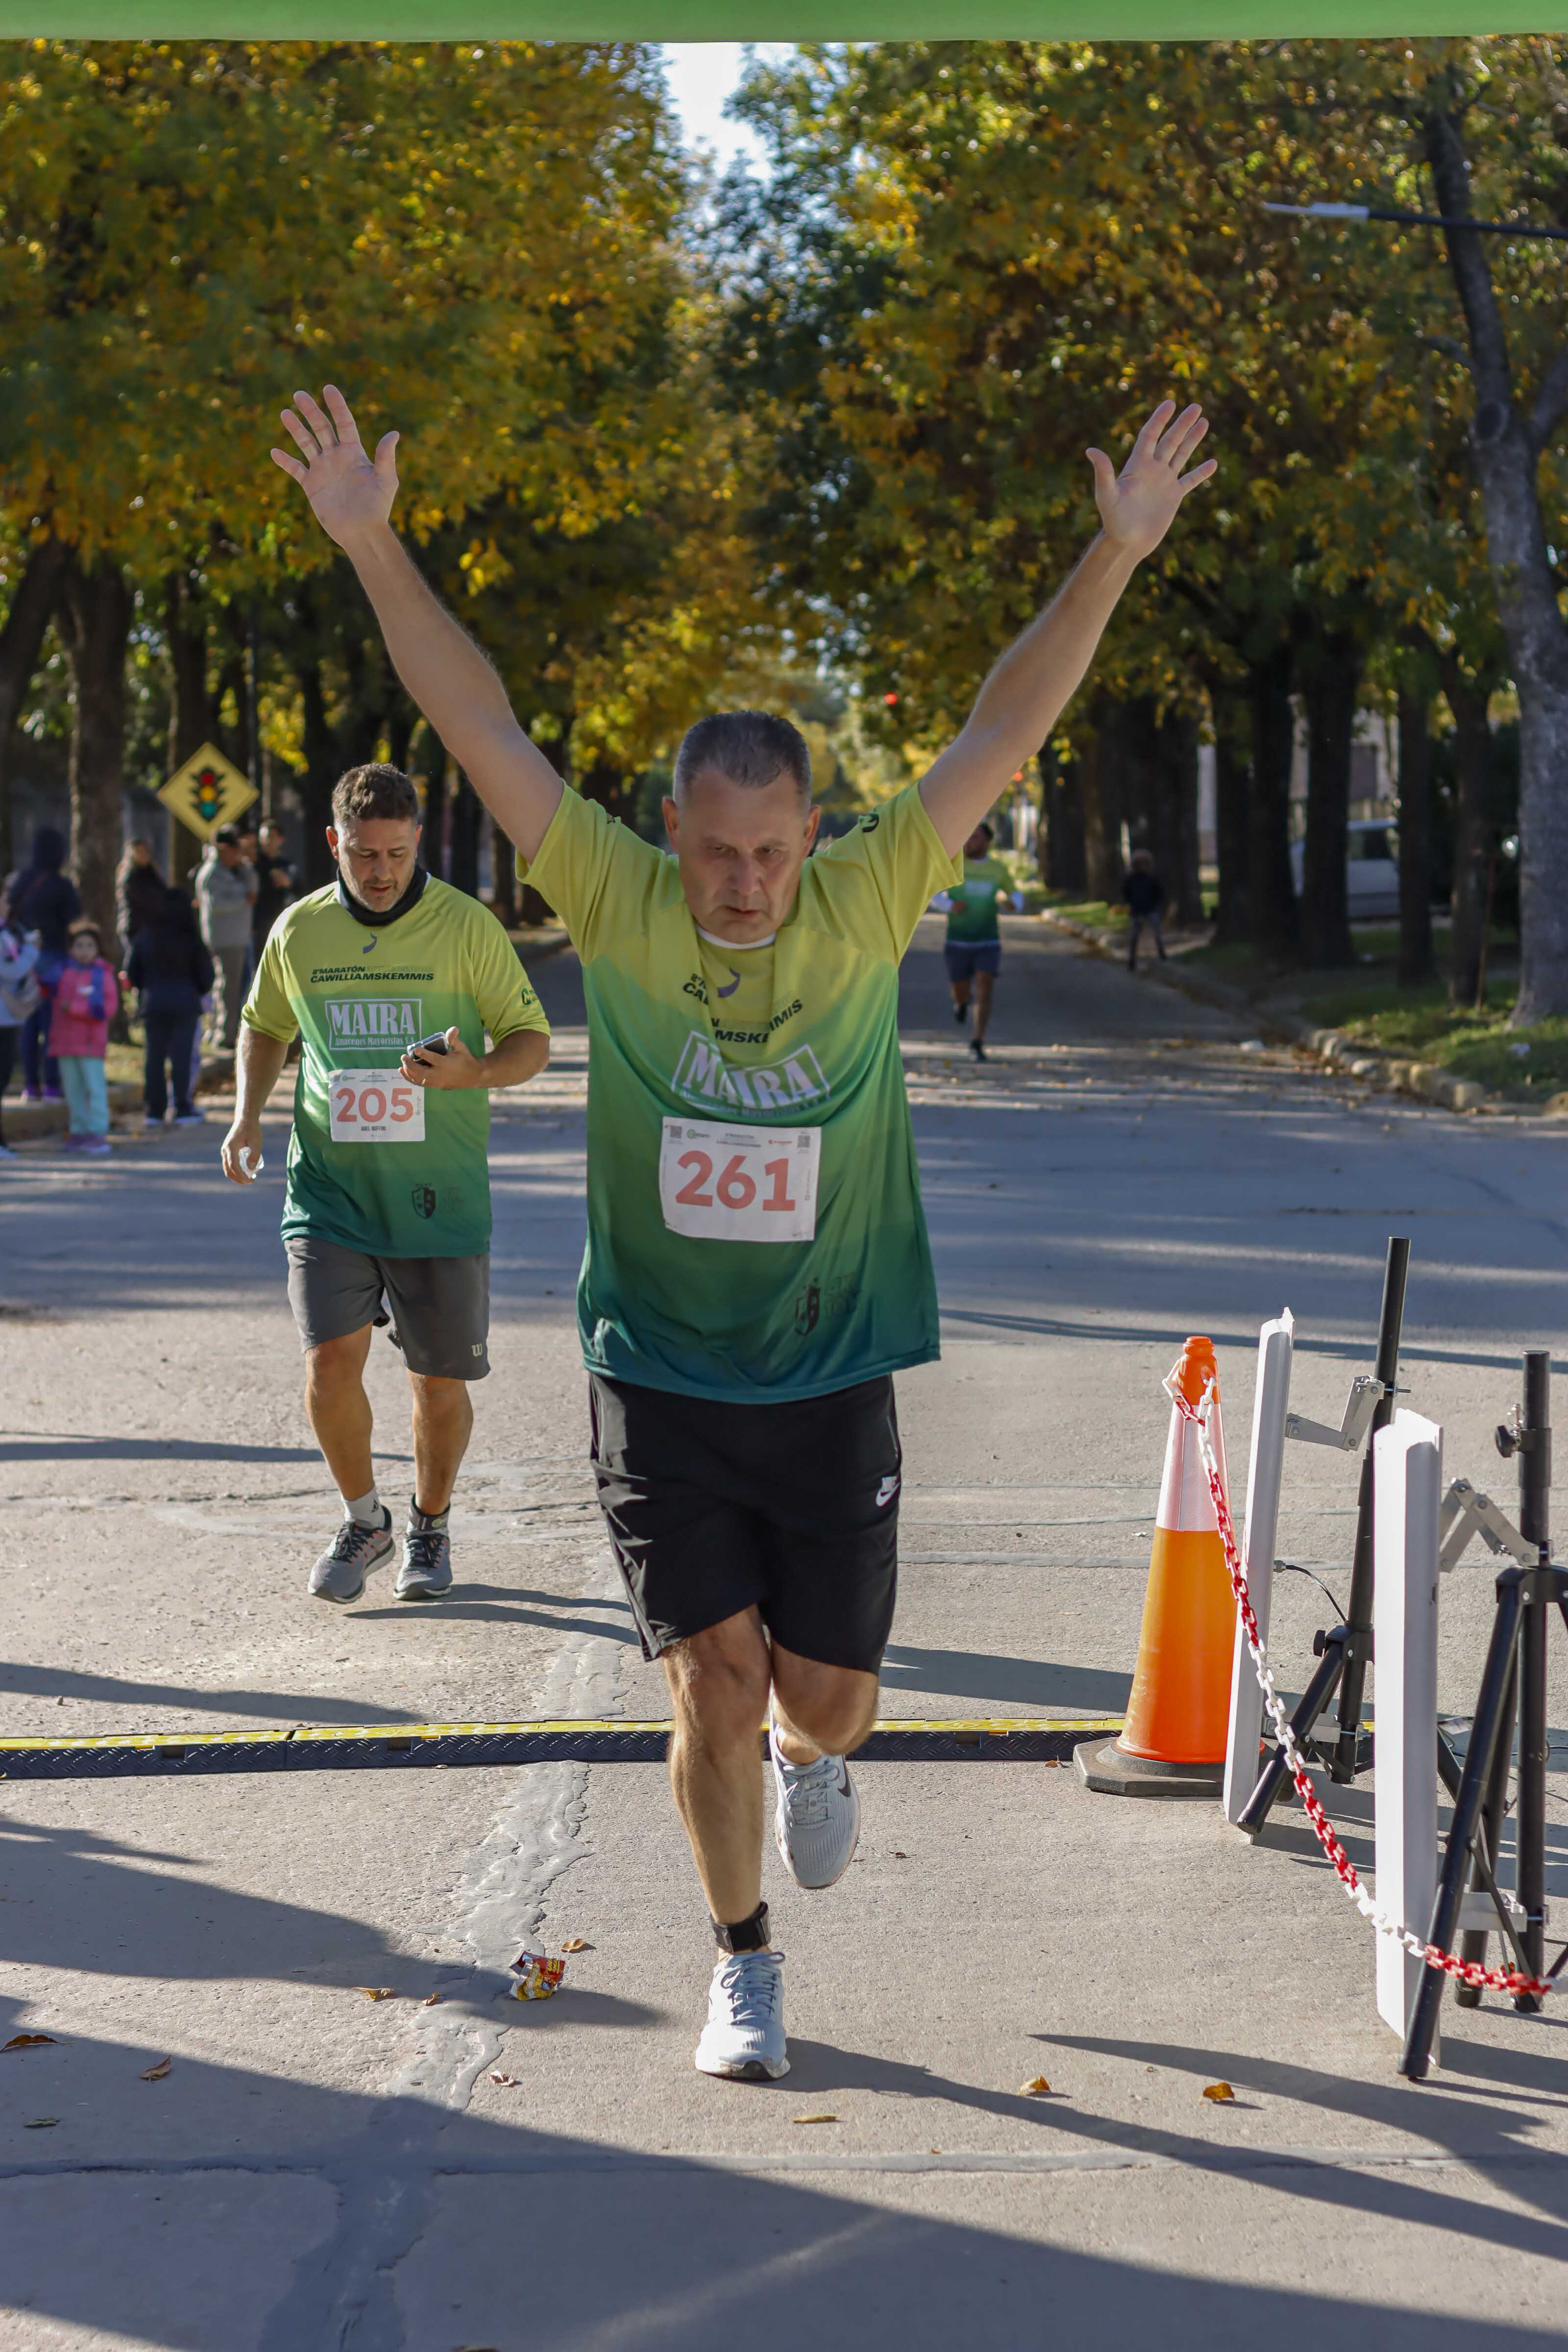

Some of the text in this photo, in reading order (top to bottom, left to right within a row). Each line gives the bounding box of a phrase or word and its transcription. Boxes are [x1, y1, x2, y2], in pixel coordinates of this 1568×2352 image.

[330, 1003, 416, 1035] MAIRA
[682, 1042, 821, 1109] MAIRA
[336, 1087, 414, 1122] 205
[675, 1150, 796, 1211] 261
